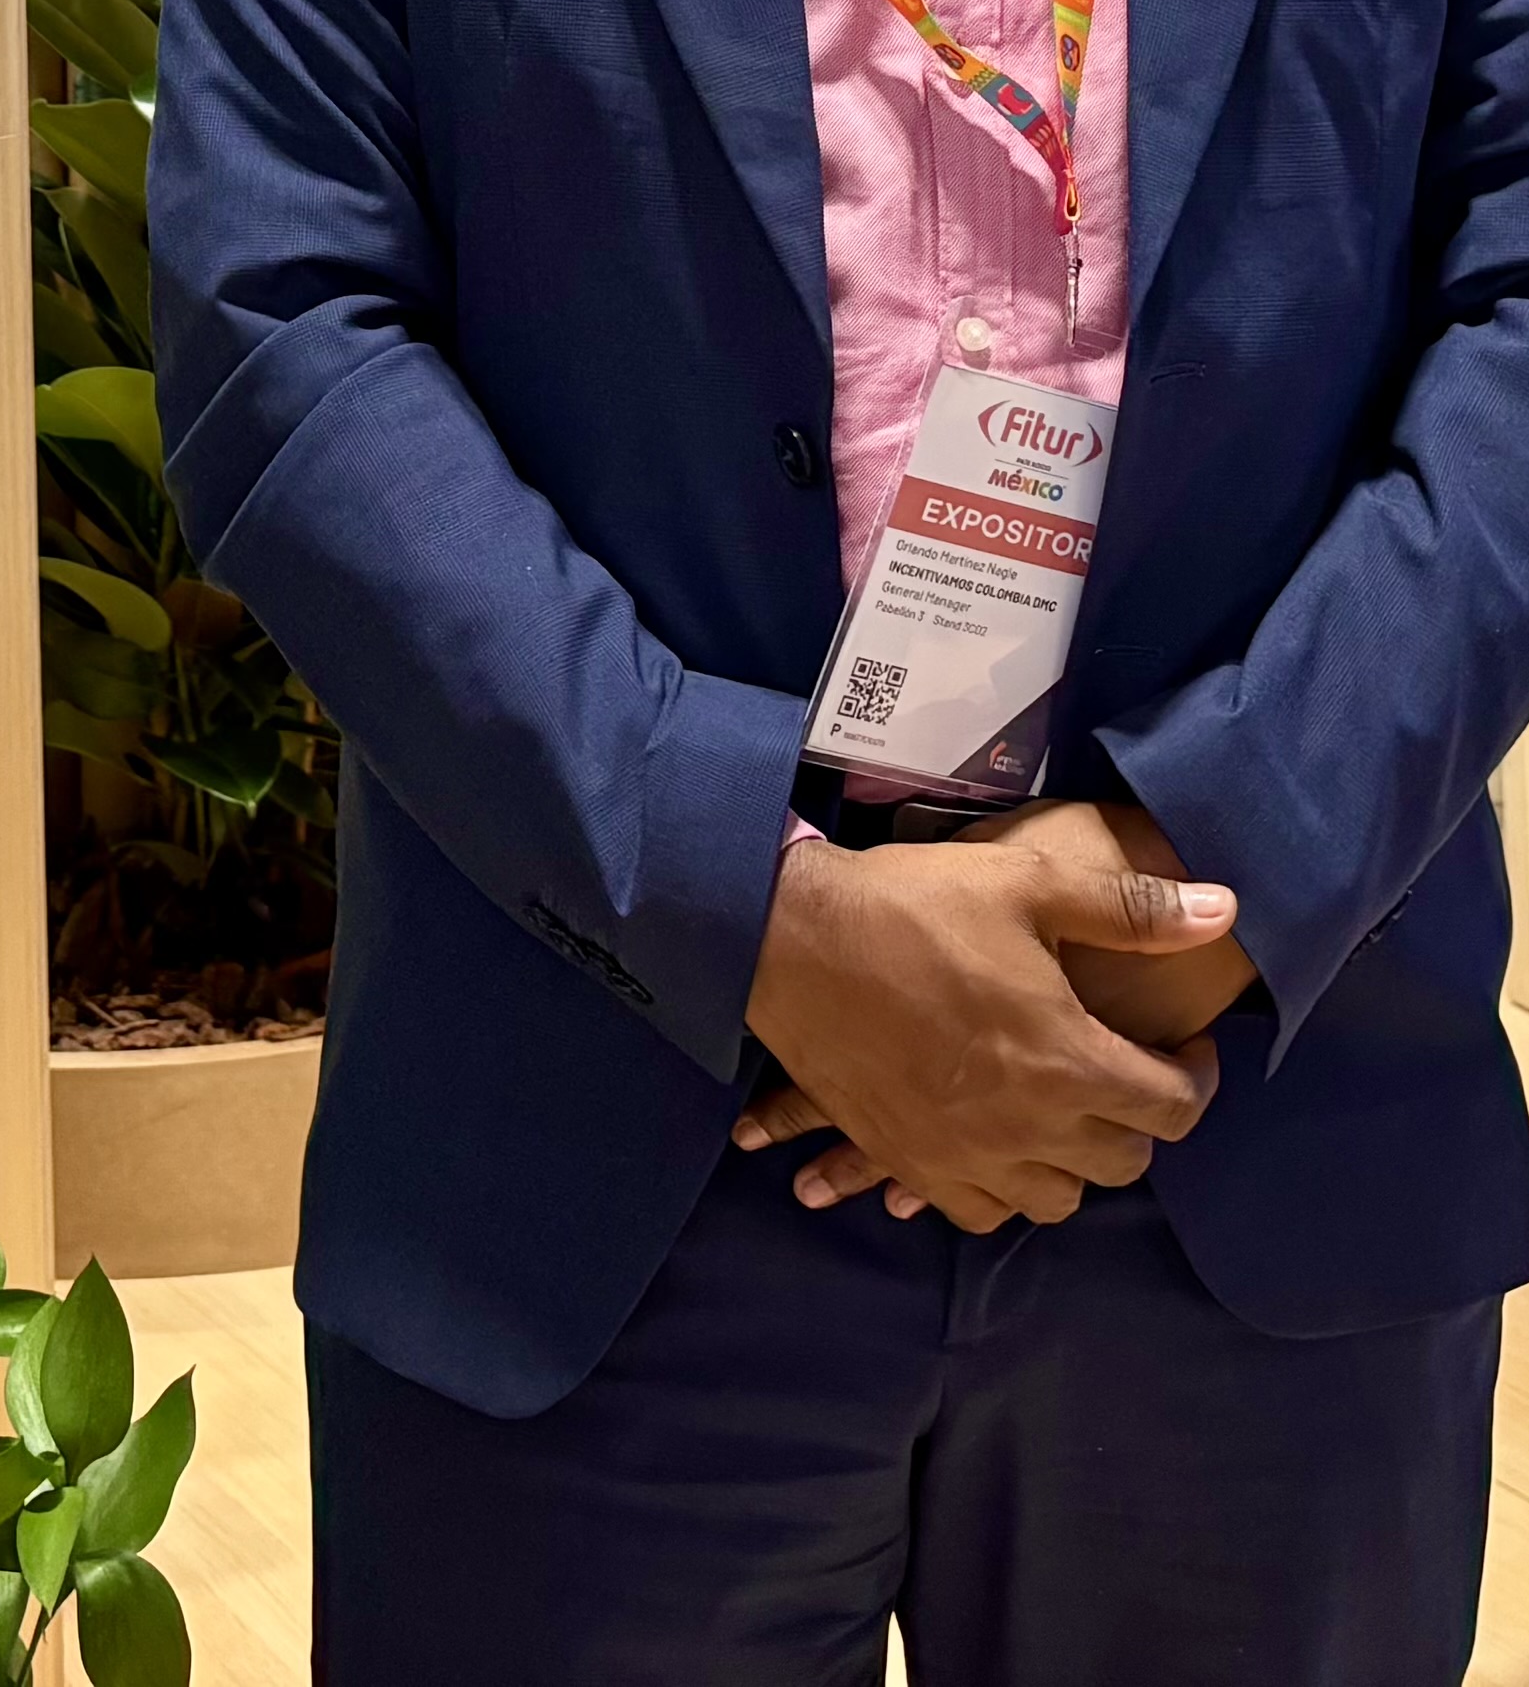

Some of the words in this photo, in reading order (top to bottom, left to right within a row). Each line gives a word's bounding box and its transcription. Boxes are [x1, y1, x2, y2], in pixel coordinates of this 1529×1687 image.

[921, 497, 1093, 563] EXPOSITOR
[896, 539, 938, 561] Orlando
[881, 581, 924, 602] General
[925, 591, 972, 614] Manager
[888, 560, 974, 592] INCENTIVAMOS
[975, 582, 1031, 607] COLOMBIA
[1032, 596, 1058, 612] DMC
[932, 614, 962, 633] Stand
[830, 723, 842, 737] P
